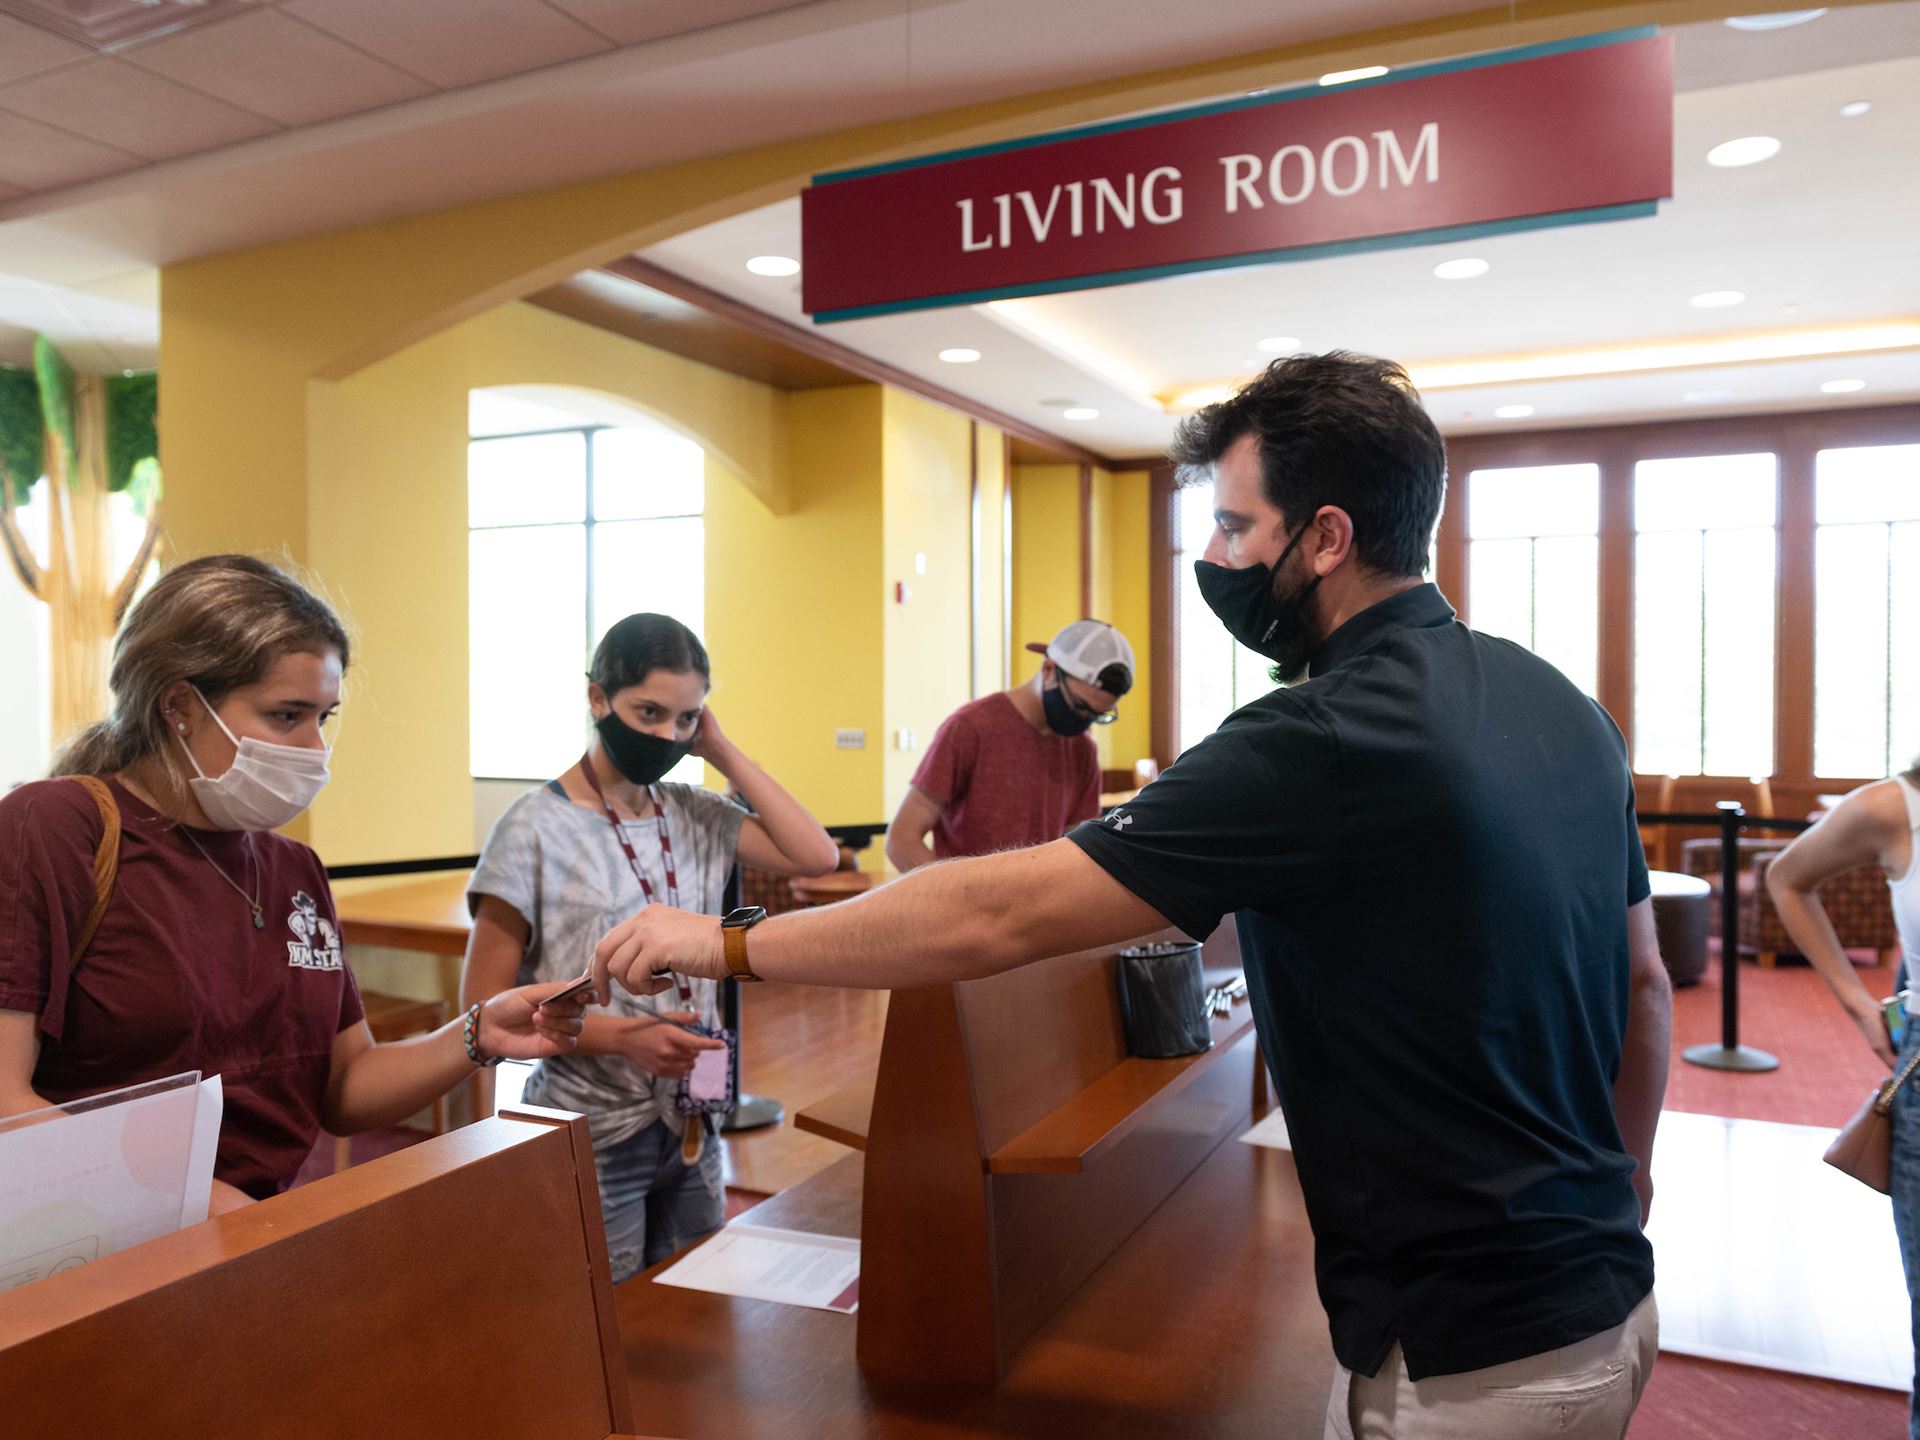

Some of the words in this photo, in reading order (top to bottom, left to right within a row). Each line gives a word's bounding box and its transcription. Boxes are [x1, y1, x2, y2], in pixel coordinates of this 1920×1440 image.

[957, 165, 1184, 252] LIVING
[1219, 122, 1441, 214] ROOM
[313, 947, 342, 969] STA
